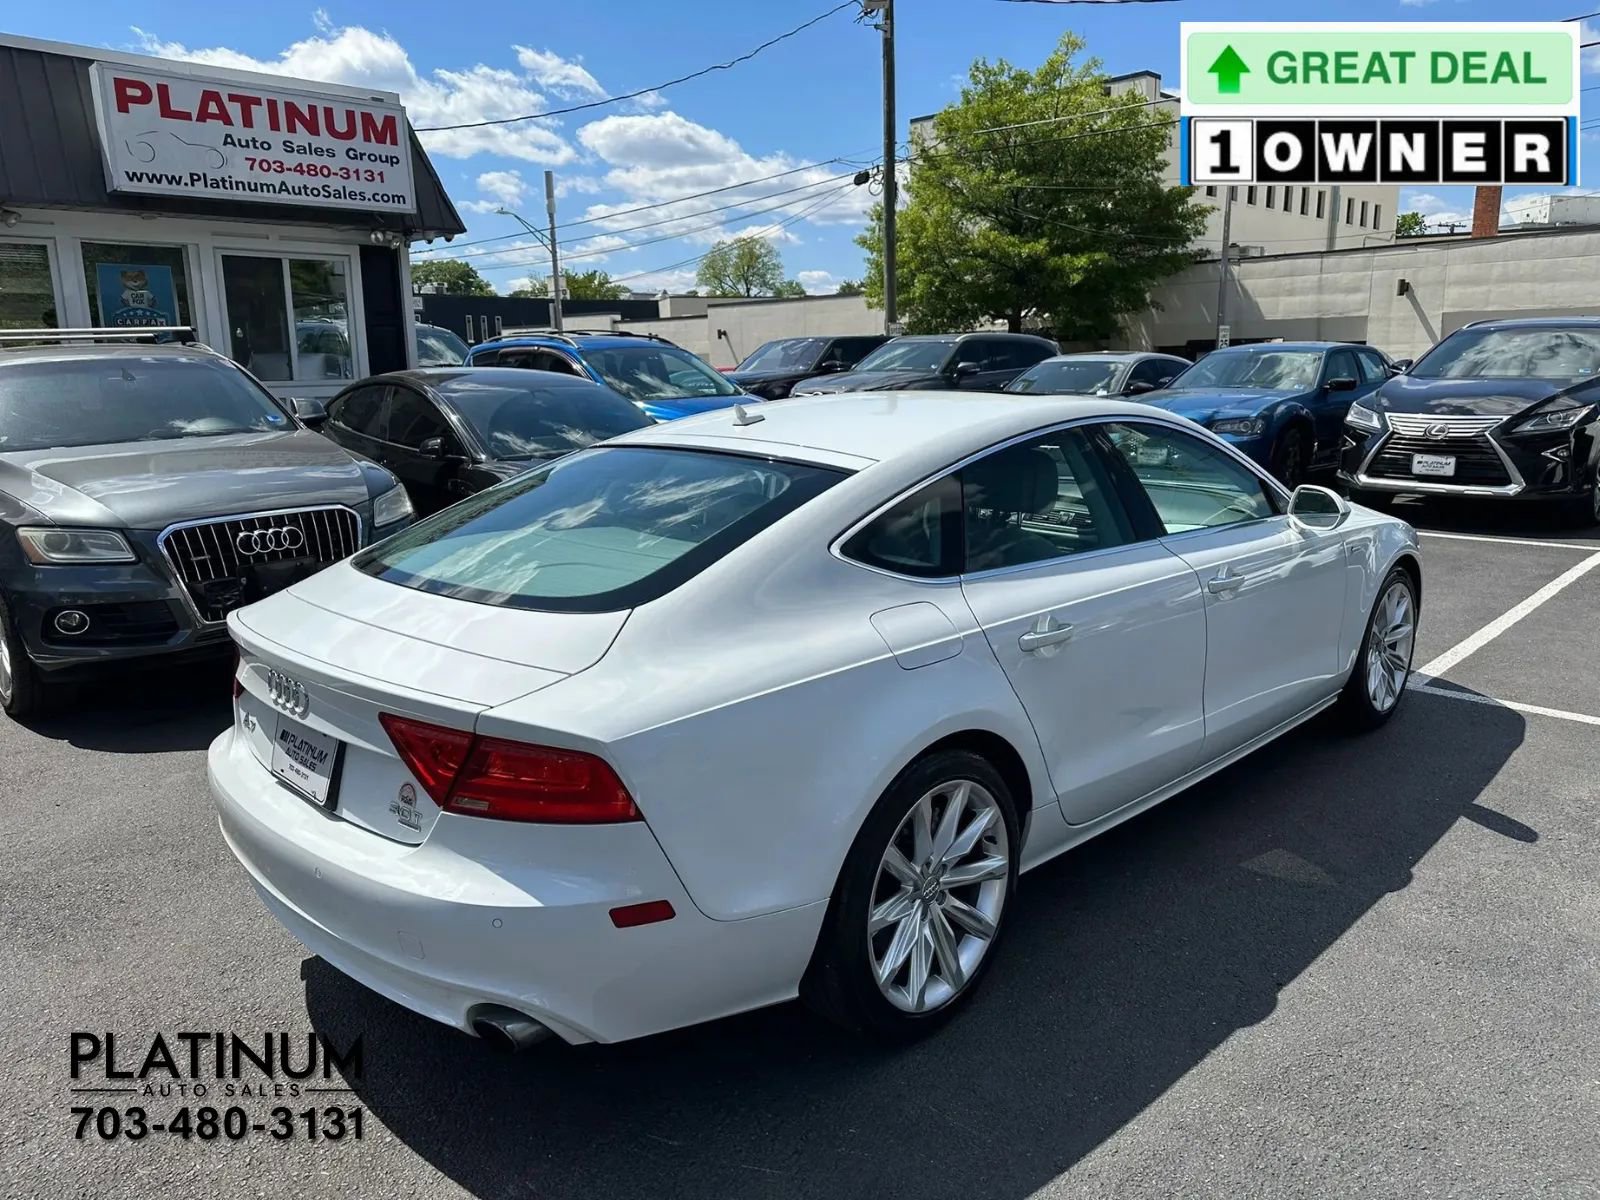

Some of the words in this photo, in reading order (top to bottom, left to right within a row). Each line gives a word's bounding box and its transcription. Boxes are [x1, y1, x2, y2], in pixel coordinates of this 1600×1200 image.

[112, 77, 399, 146] PLATINUM
[222, 133, 273, 151] Auto
[282, 140, 337, 159] Sales
[345, 148, 400, 167] Group
[244, 157, 386, 184] 703-480-3131
[124, 170, 407, 205] www.PlatinumAutoSales.com
[285, 747, 300, 761] AUTO
[299, 755, 318, 772] SALES
[287, 732, 329, 765] PLATINUM
